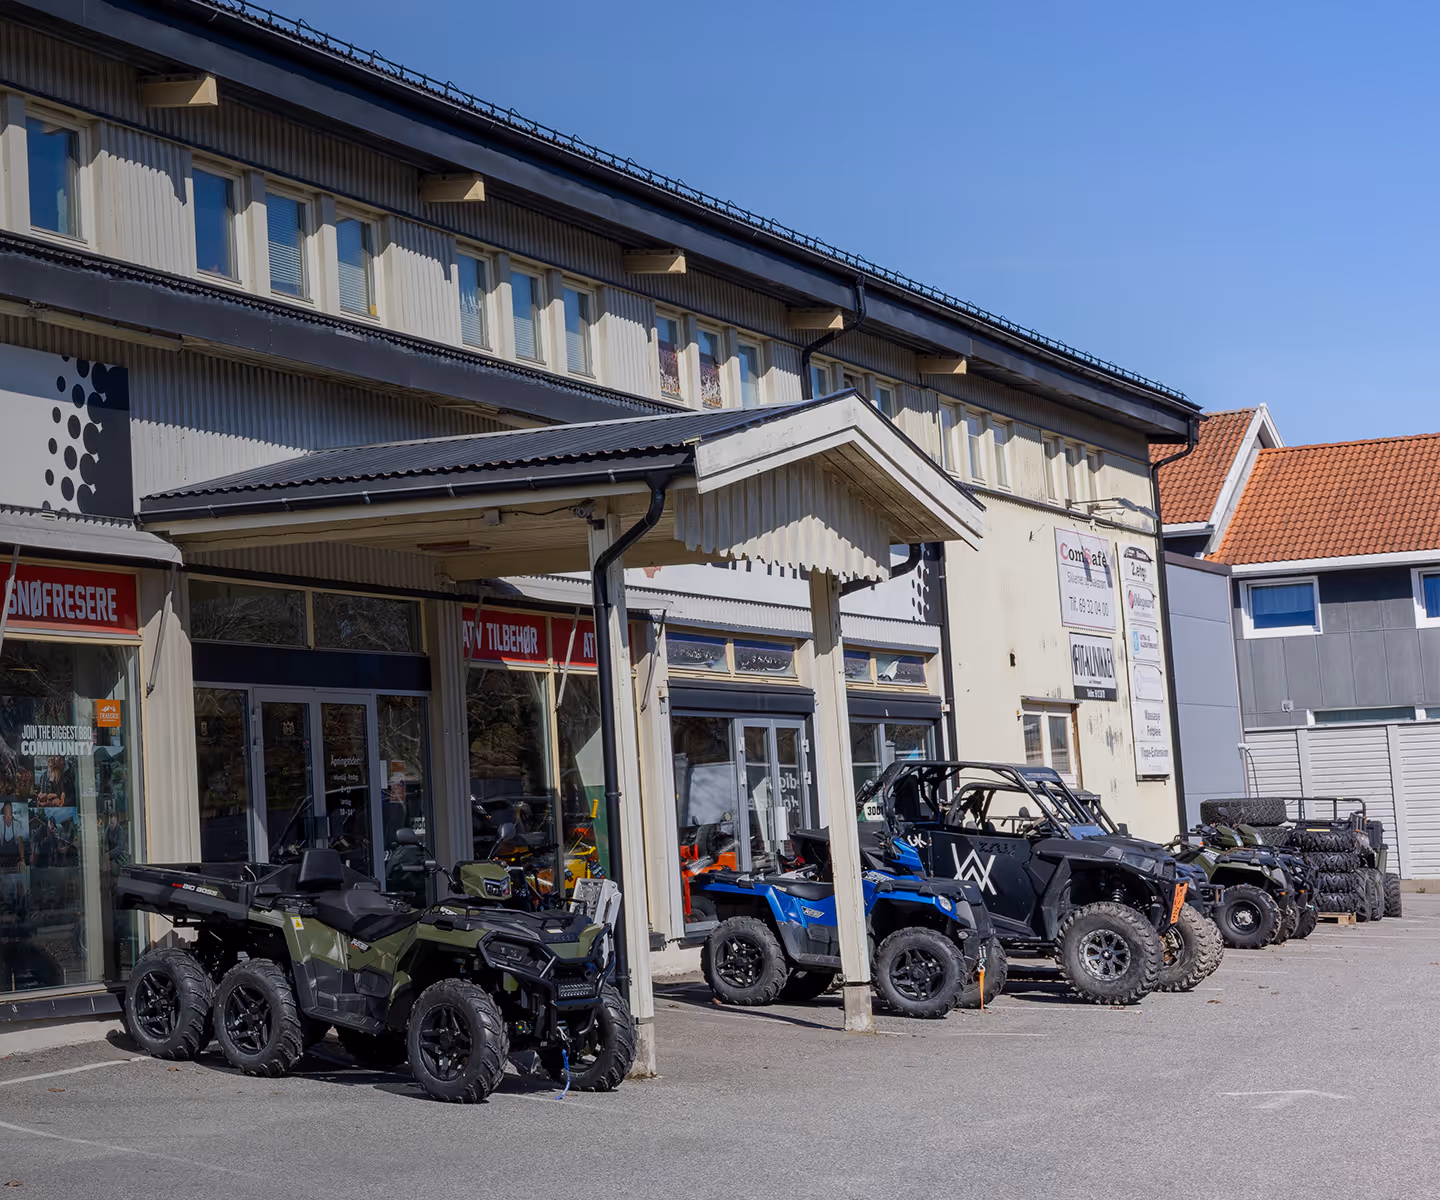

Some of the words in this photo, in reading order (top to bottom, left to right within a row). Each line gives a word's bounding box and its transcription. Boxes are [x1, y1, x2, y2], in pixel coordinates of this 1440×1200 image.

[1060, 542, 1108, 568] ComSafe
[5, 579, 118, 622] SNØFRESERE
[462, 620, 482, 649] ATV
[486, 622, 538, 655] TILBEHØR
[583, 632, 594, 659] AT
[99, 712, 120, 720] TRAEGER
[21, 724, 38, 740] JOIN
[38, 725, 51, 740] THE
[51, 725, 78, 740] BIGGEST
[20, 740, 94, 756] COMMUNITY
[182, 883, 196, 891] BIG
[196, 886, 218, 897] BOSS
